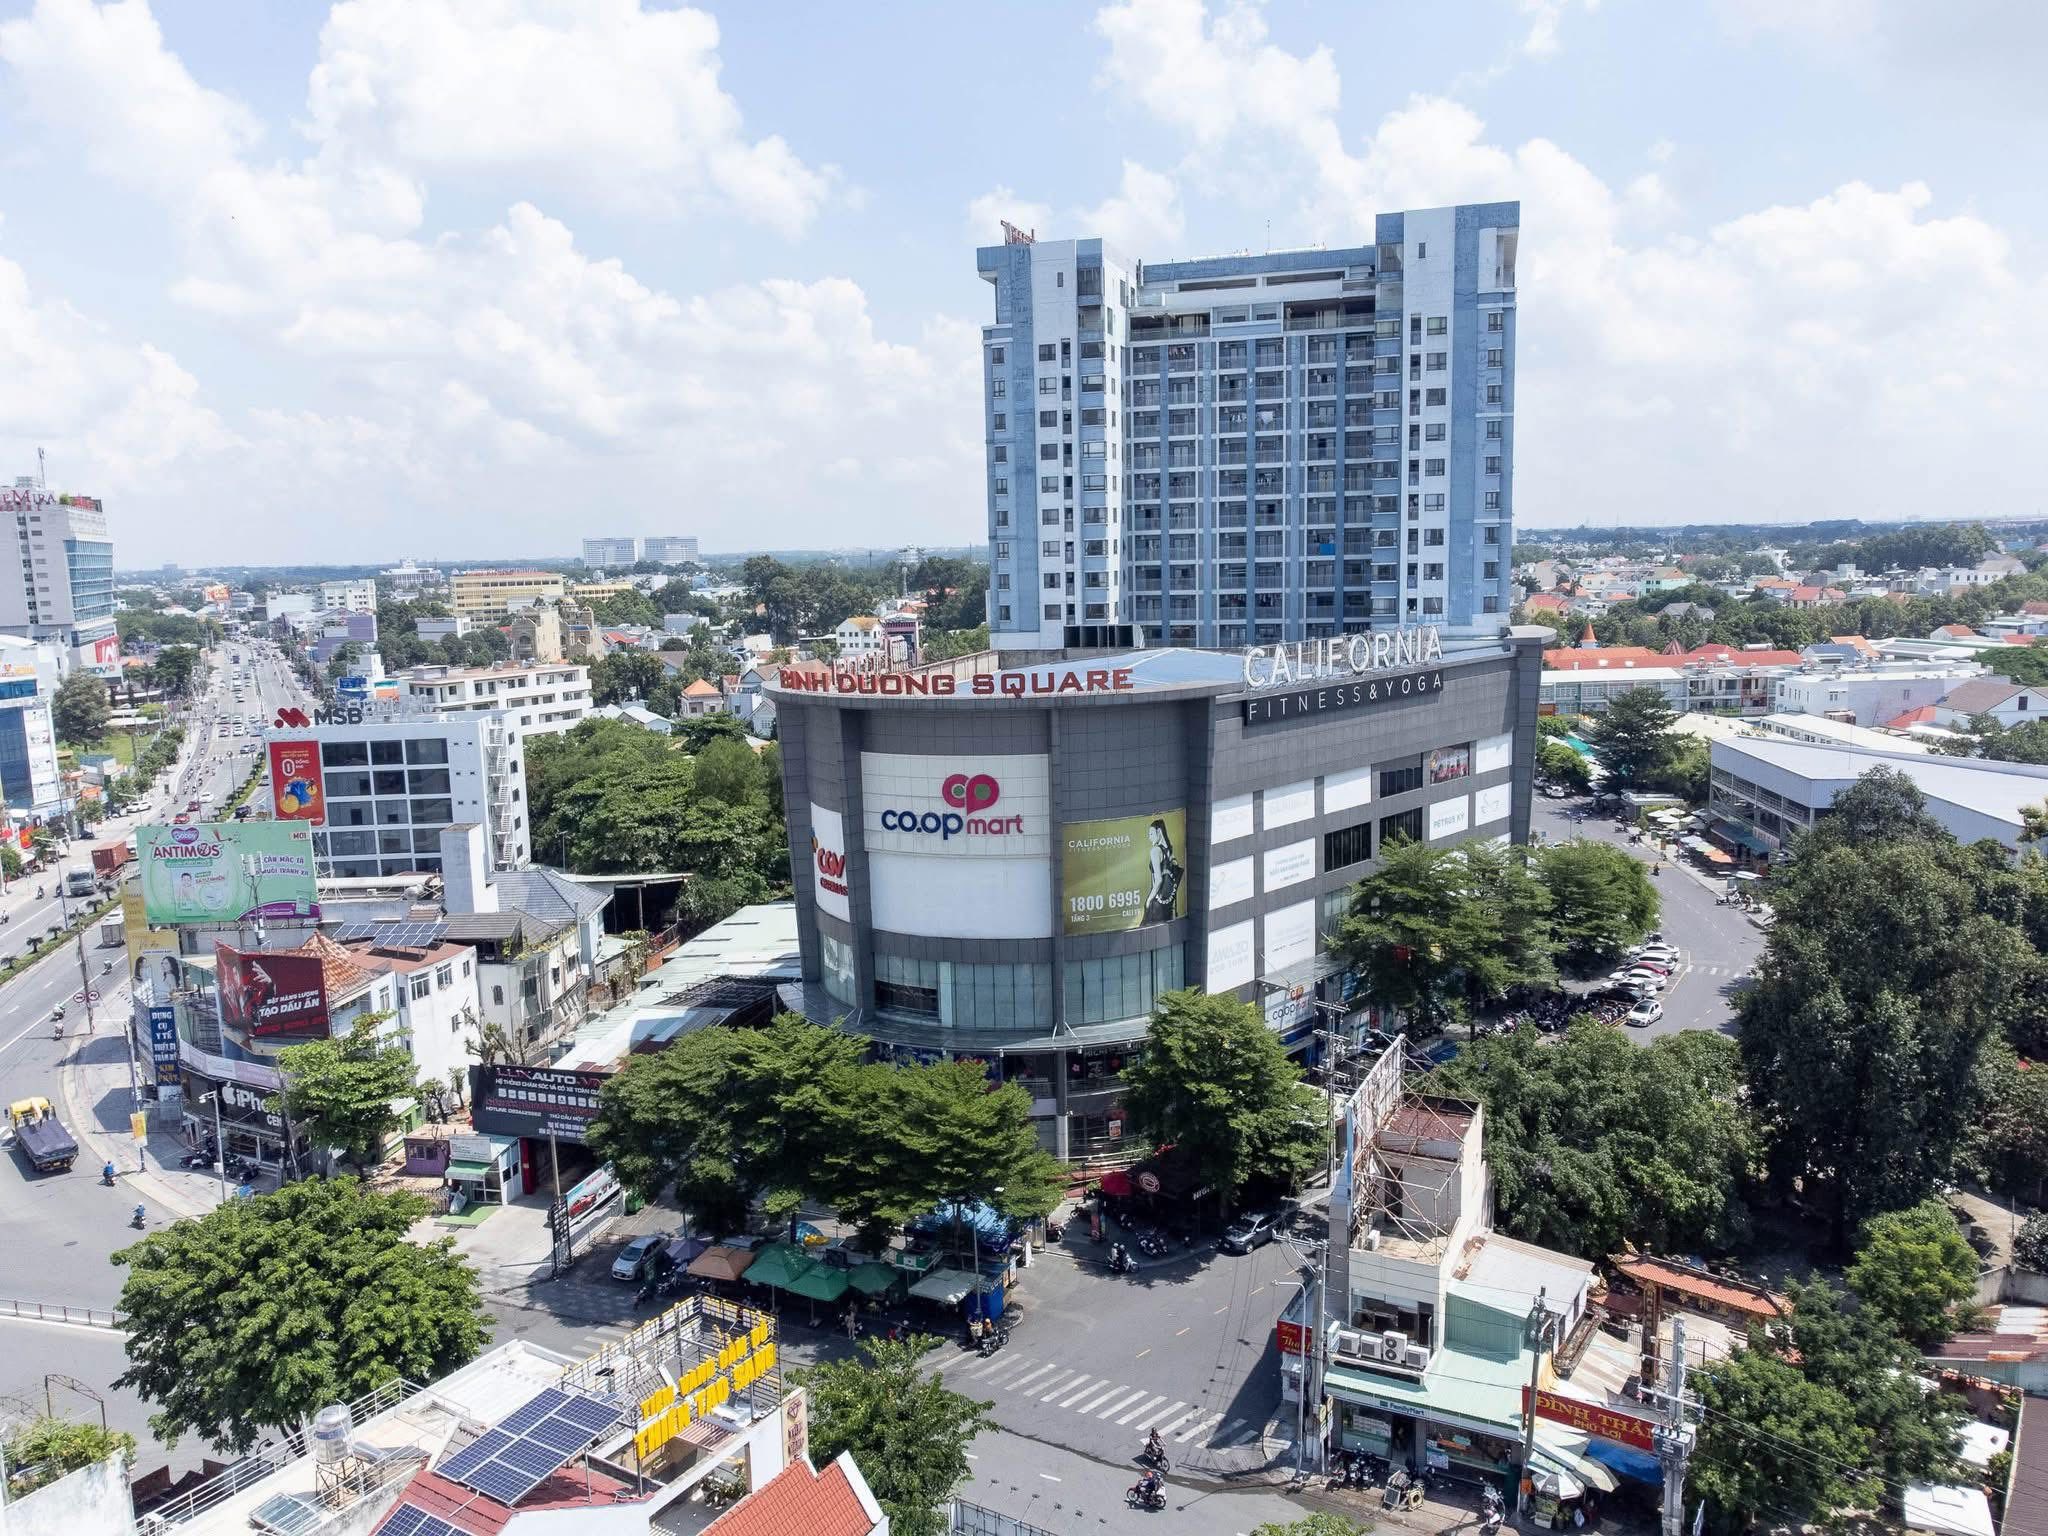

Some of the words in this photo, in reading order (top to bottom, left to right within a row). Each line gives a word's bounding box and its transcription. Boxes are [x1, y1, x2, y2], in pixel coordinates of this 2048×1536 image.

[1243, 625, 1443, 688] CALIFORNIA
[972, 668, 1134, 699] SQUARE
[314, 708, 363, 726] MSB
[1068, 835, 1132, 849] CALIFORNIA
[1070, 894, 1104, 912] 1800
[1108, 889, 1141, 909] 6995
